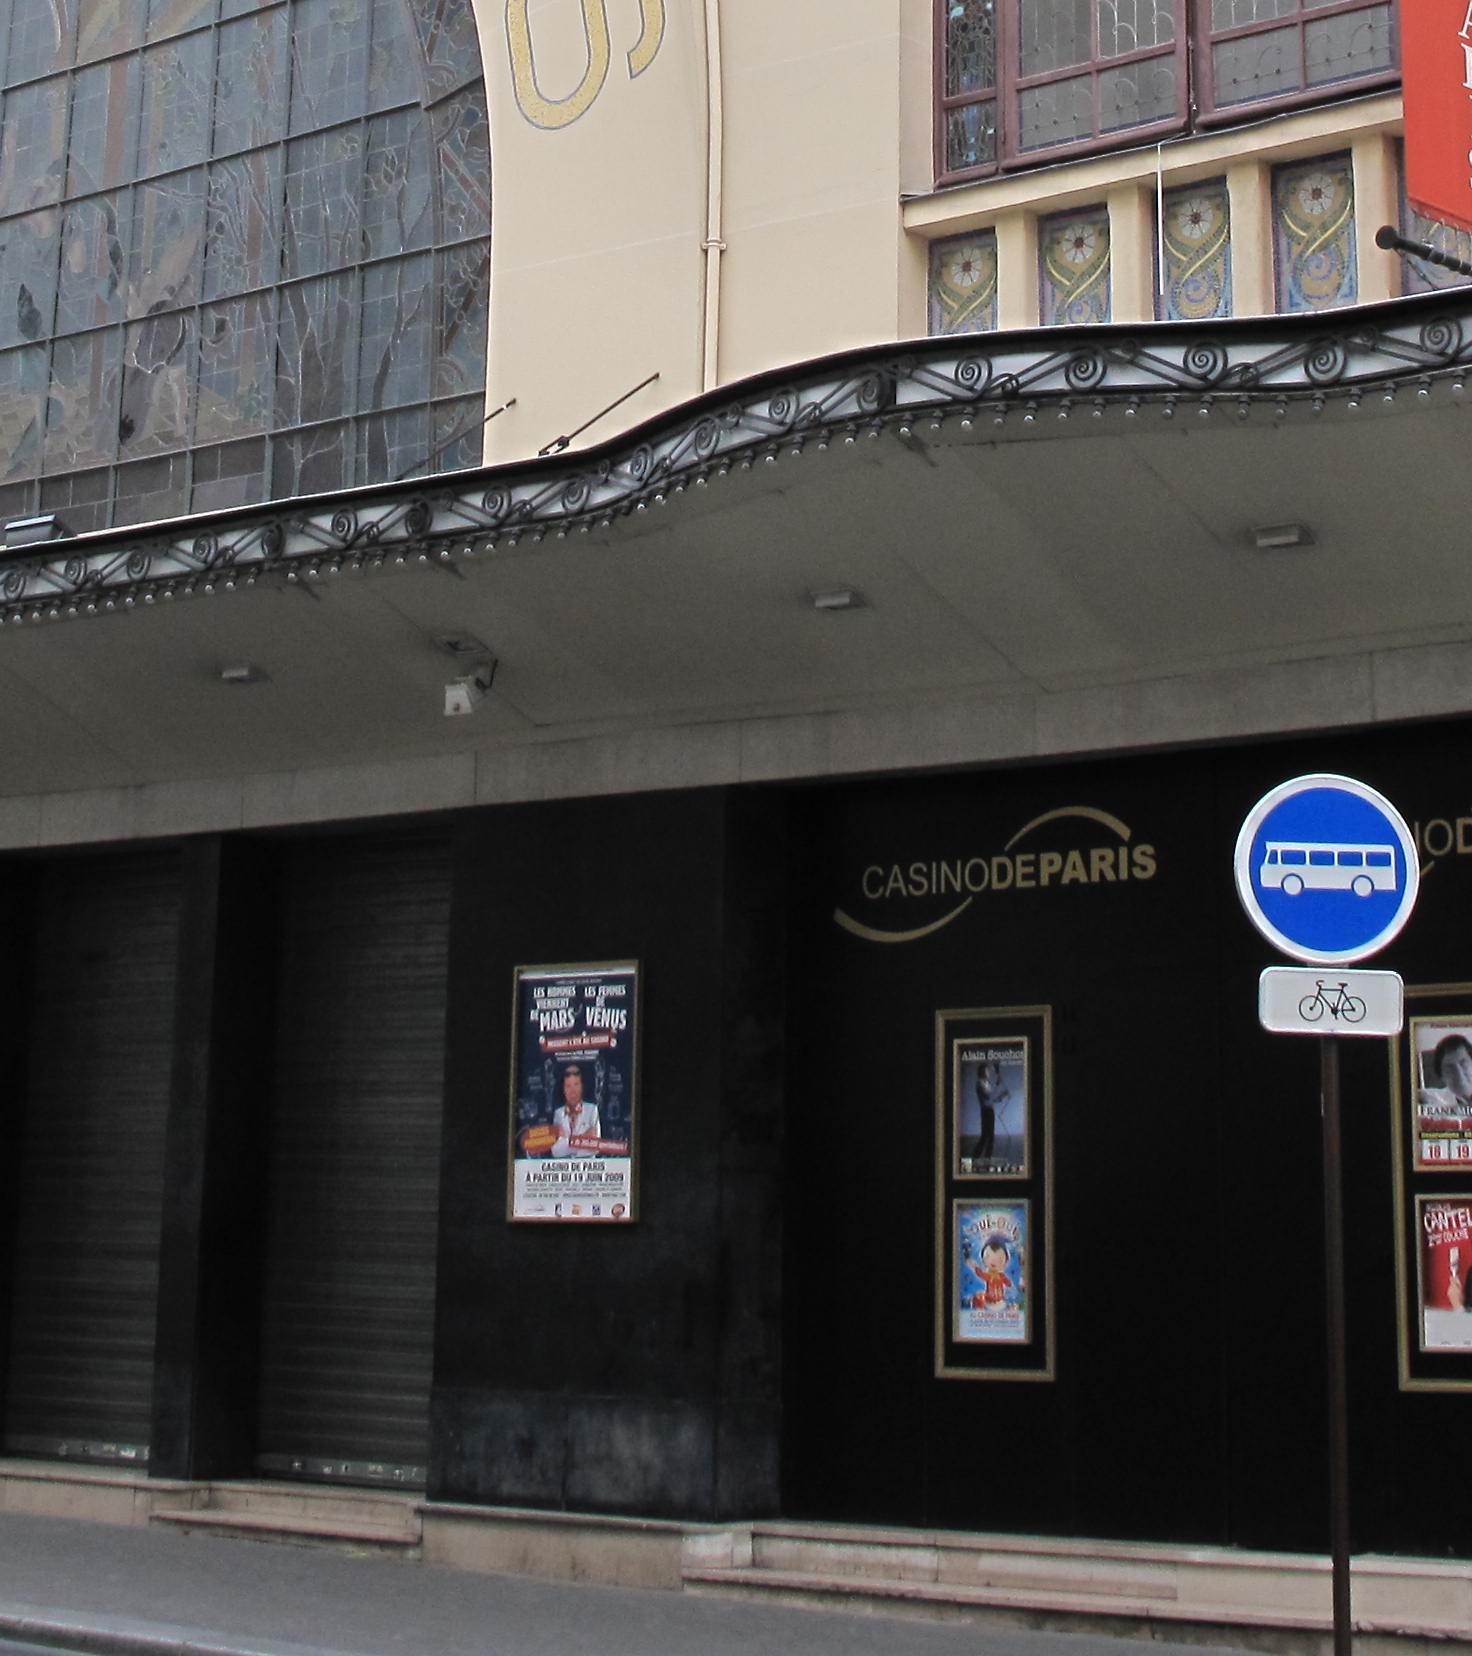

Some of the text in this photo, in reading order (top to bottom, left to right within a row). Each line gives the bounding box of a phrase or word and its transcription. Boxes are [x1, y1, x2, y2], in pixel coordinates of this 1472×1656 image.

[862, 844, 1158, 899] CASINODEPARIS
[539, 1008, 576, 1032] MARS
[541, 1162, 569, 1172] CASINO
[583, 1161, 606, 1171] PARIS
[532, 1173, 559, 1183] PARTIR
[585, 1172, 603, 1182] JUIN
